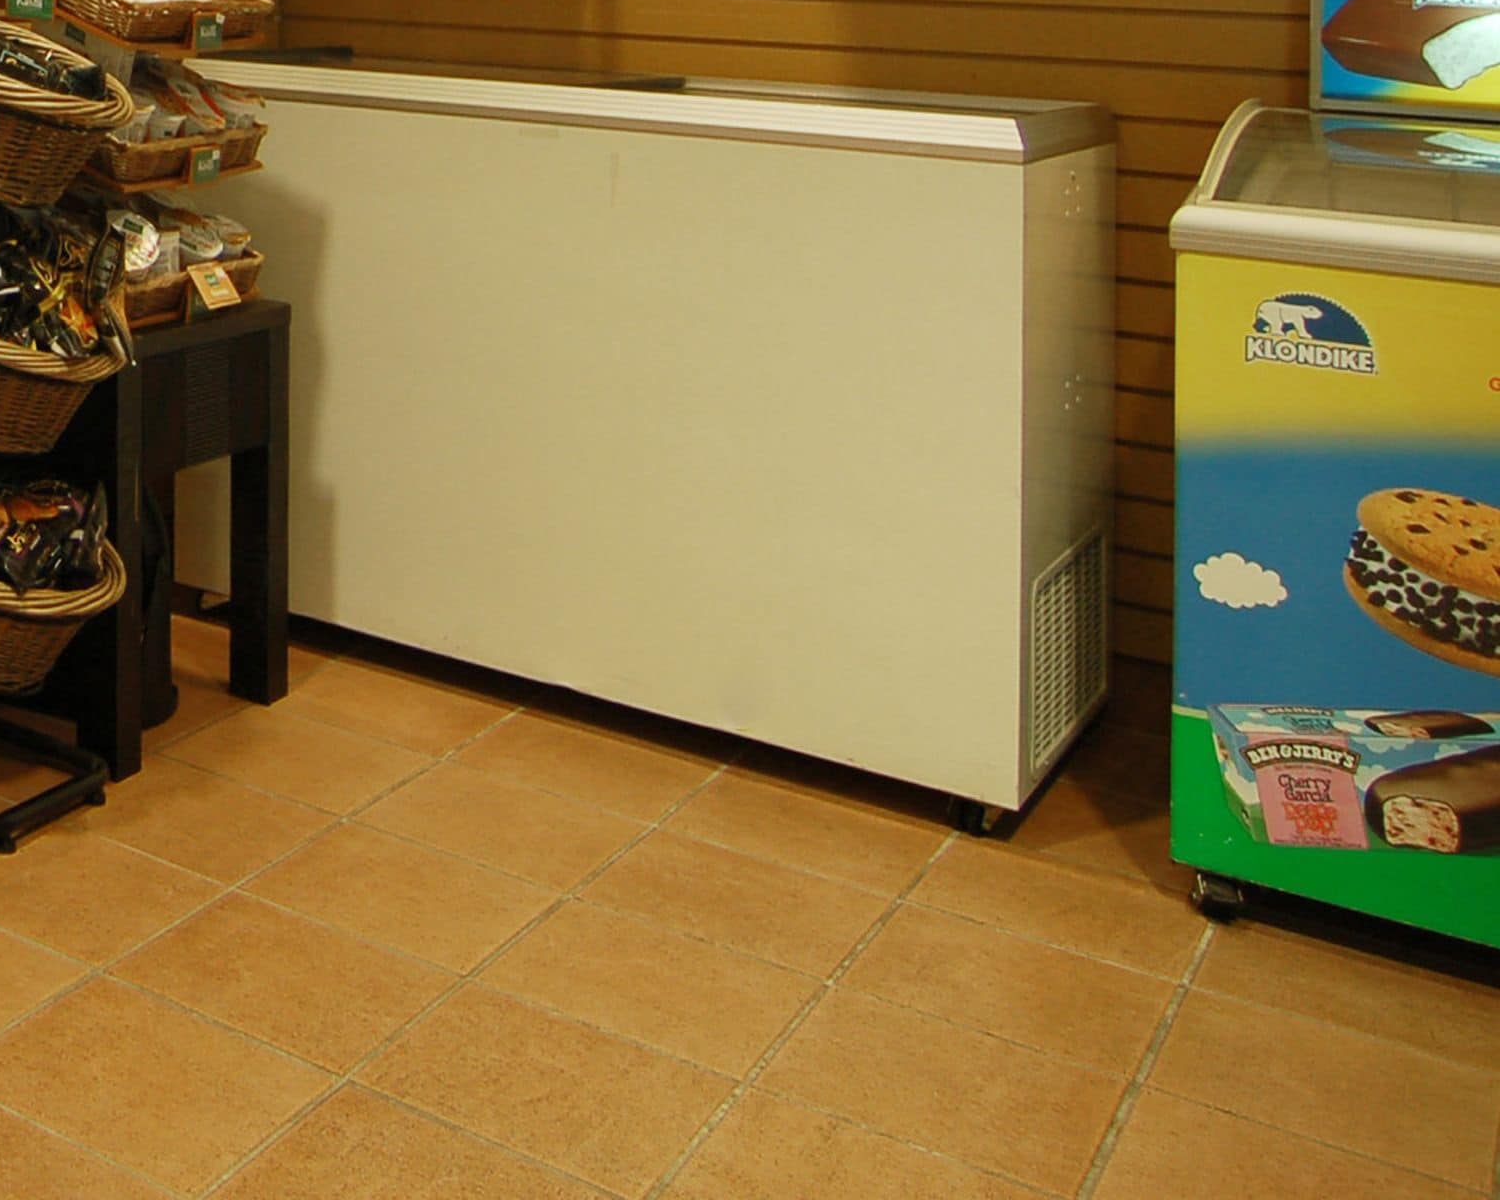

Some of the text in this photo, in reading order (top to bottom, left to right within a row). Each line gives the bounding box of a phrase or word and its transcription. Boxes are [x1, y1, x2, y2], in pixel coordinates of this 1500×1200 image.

[1246, 336, 1375, 374] KLONDIKE
[1247, 745, 1278, 765] BEN
[1291, 742, 1357, 769] JERRY'S
[1278, 773, 1332, 793] Cherry
[1284, 788, 1333, 803] Garcia
